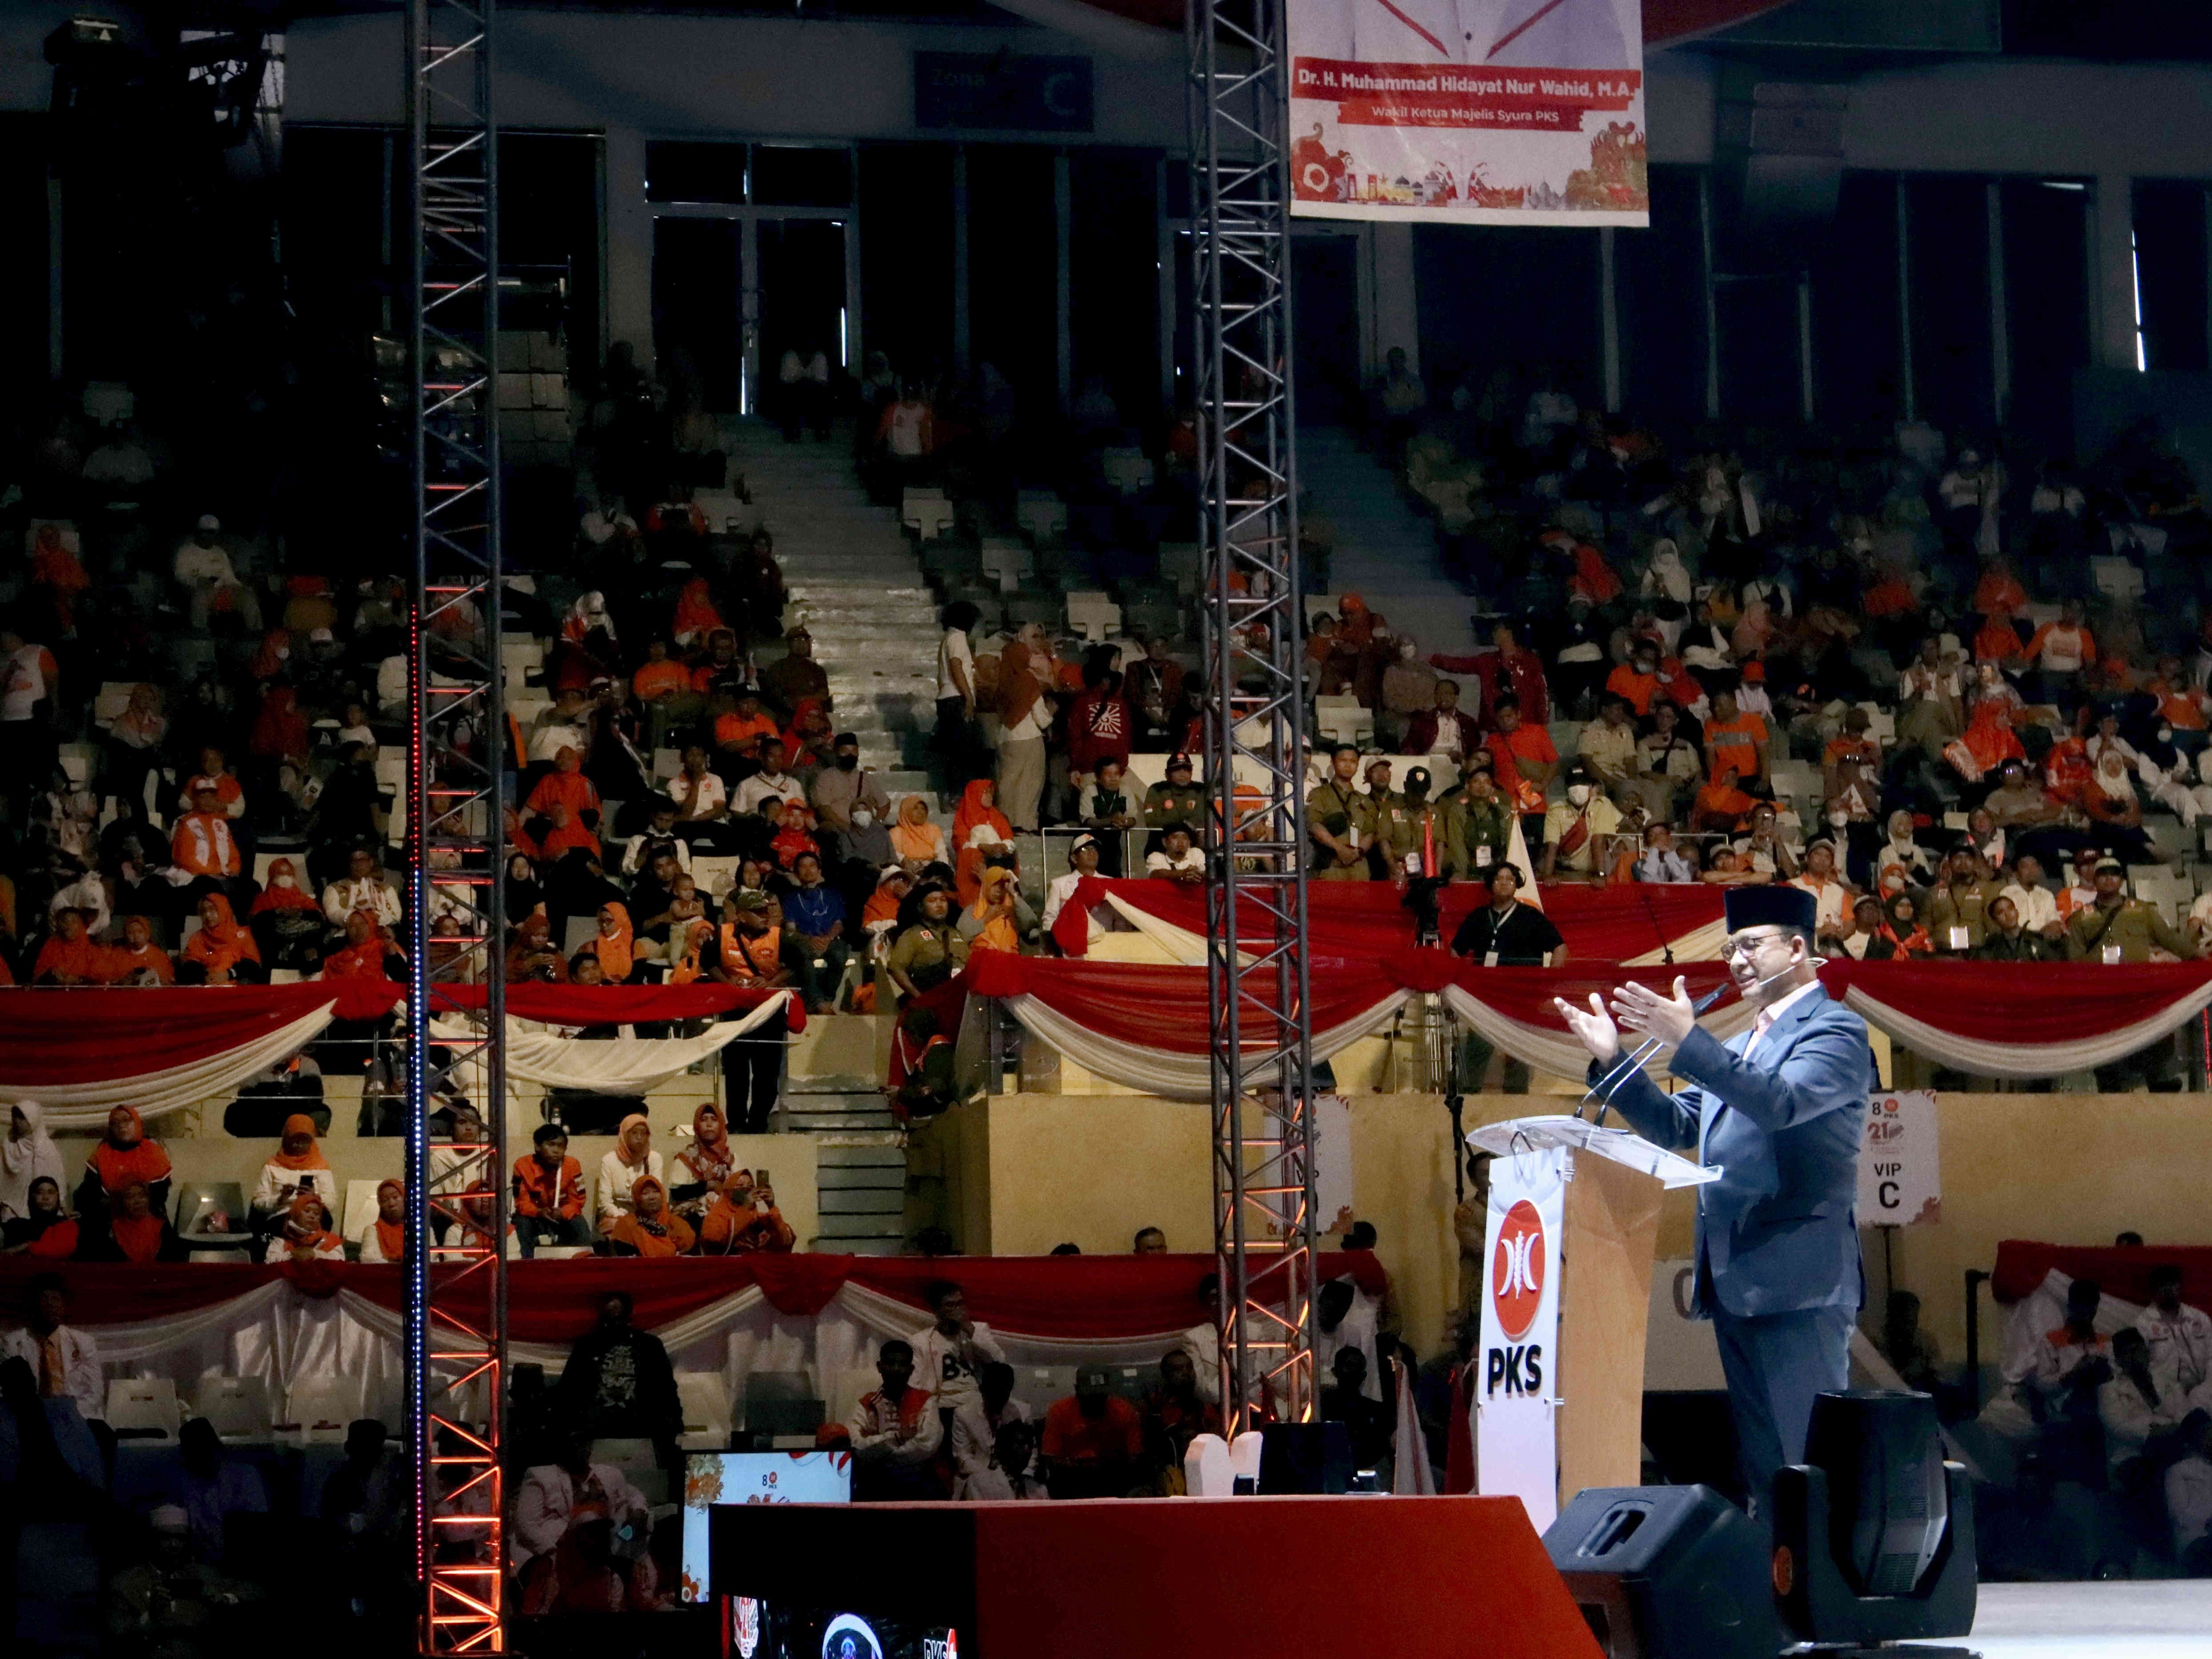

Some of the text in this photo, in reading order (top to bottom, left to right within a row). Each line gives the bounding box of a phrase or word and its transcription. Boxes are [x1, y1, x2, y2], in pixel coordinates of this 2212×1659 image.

[1043, 72, 1076, 116] C
[1298, 69, 1634, 97] Dr. H. Muhammad Hidayat Nur Wahid, M.A.
[1372, 106, 1560, 123] Wakil Ketua Majelis Syura PKS
[1872, 1102, 1881, 1115] 8
[1874, 1162, 1901, 1177] VIP
[1879, 1181, 1901, 1209] C
[1488, 1344, 1542, 1394] PKS
[762, 1474, 768, 1486] 8
